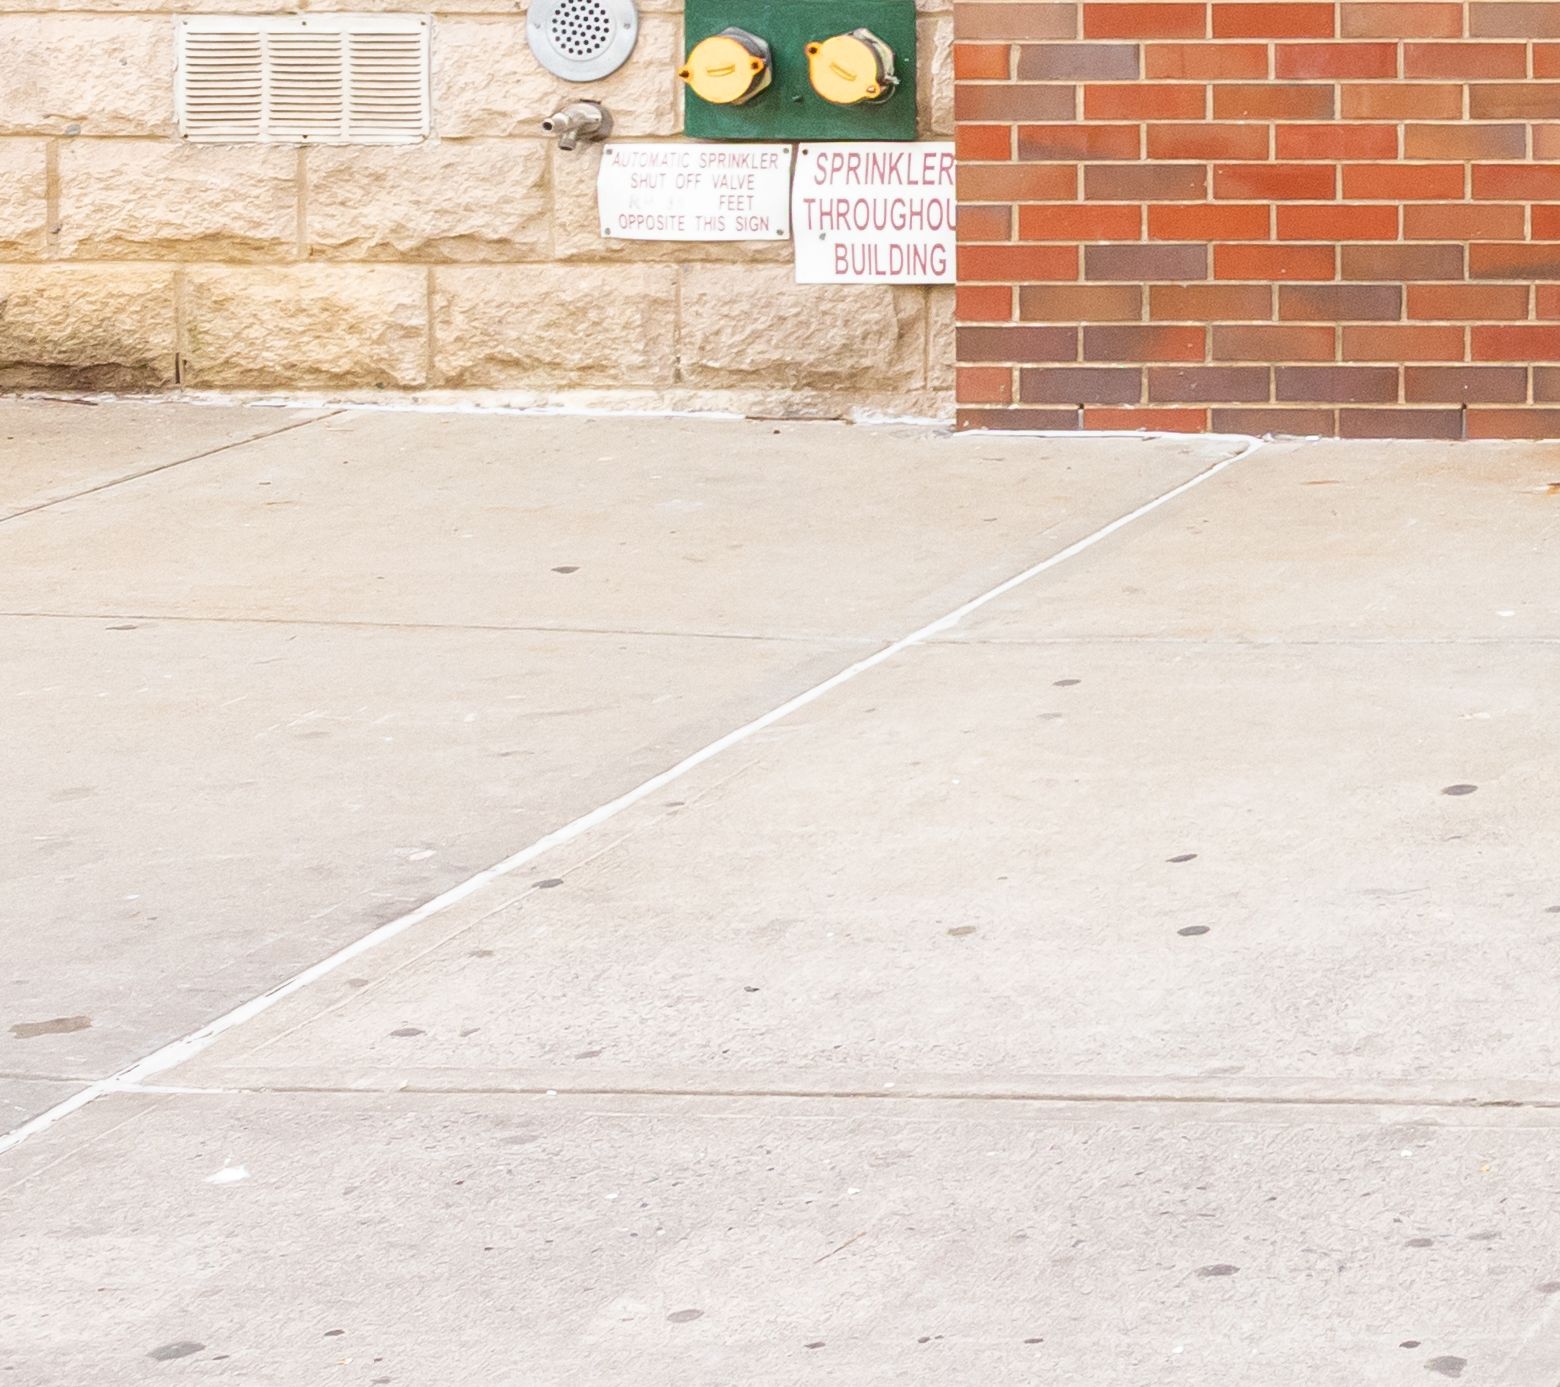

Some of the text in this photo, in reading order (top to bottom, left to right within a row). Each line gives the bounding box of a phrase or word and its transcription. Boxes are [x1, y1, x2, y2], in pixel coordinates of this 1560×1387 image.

[612, 152, 779, 169] AUTOMATIC SPRINKLER
[814, 152, 955, 186] SPRINKLER
[630, 173, 755, 190] SHUT OFF VALVE
[719, 195, 755, 211] FEET
[618, 214, 770, 232] OPPOSITE THIS SIGN
[803, 197, 957, 231] THROUGHOU
[834, 243, 947, 276] BUILDING
